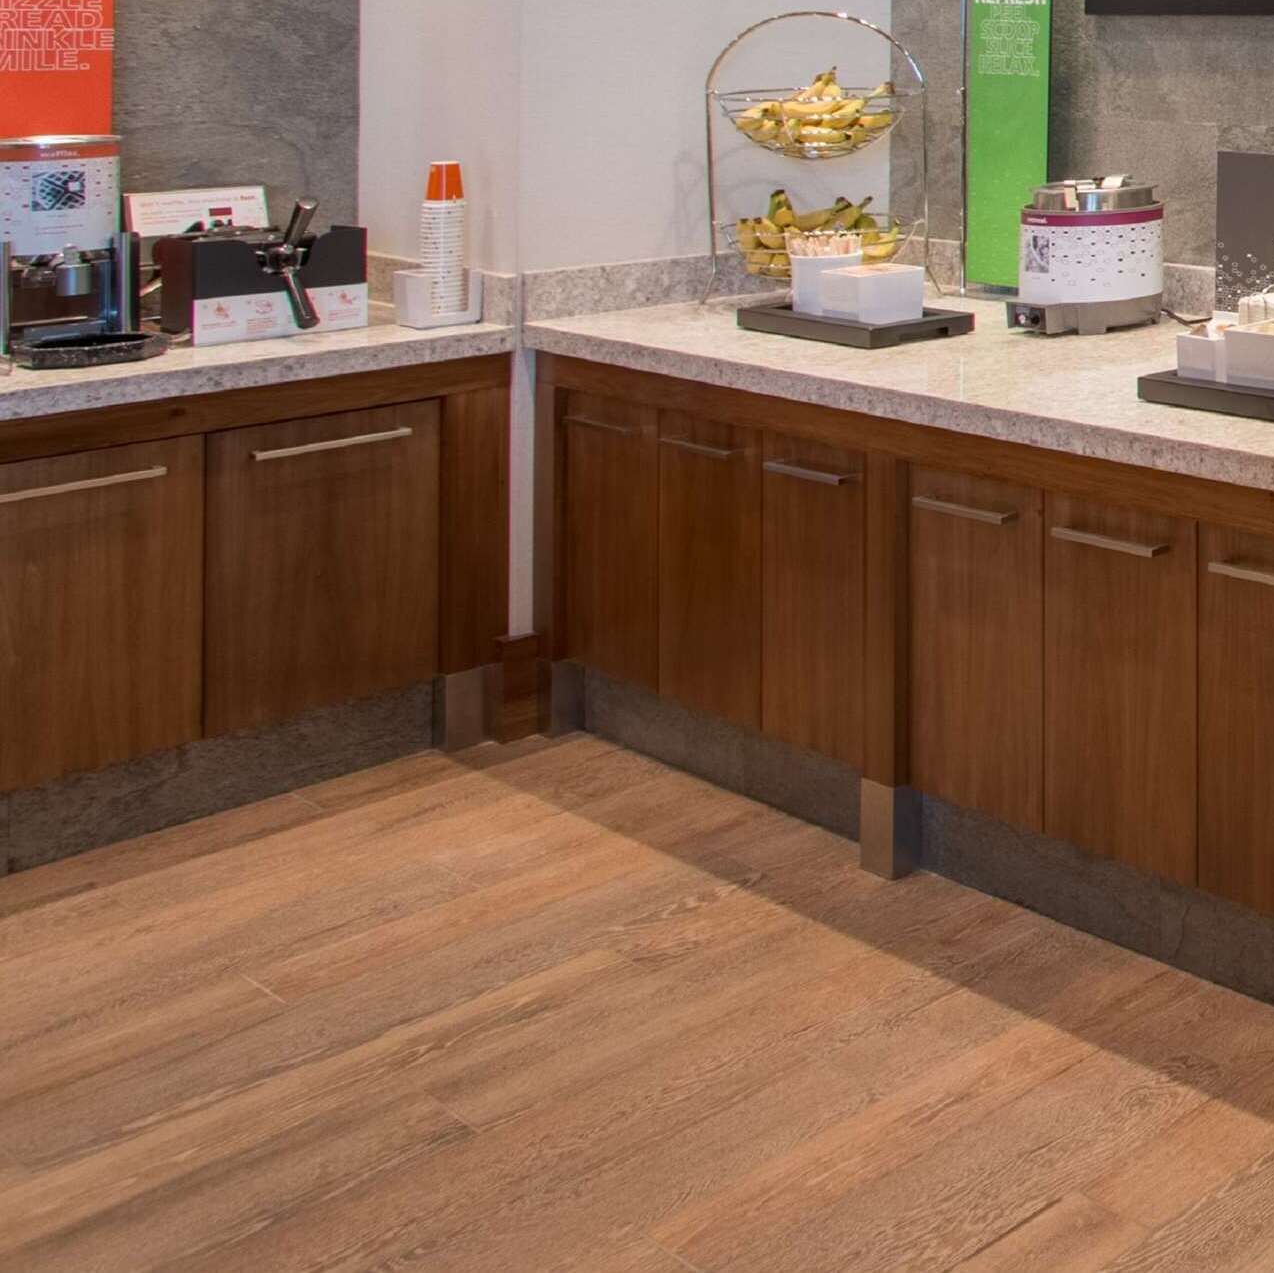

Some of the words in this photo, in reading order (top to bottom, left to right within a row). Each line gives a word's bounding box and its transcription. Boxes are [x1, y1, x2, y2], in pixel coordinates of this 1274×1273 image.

[0, 28, 116, 50] INKLE
[980, 19, 1041, 40] SCOOP
[984, 37, 1036, 59] SLICE
[978, 54, 1040, 78] RELAX.
